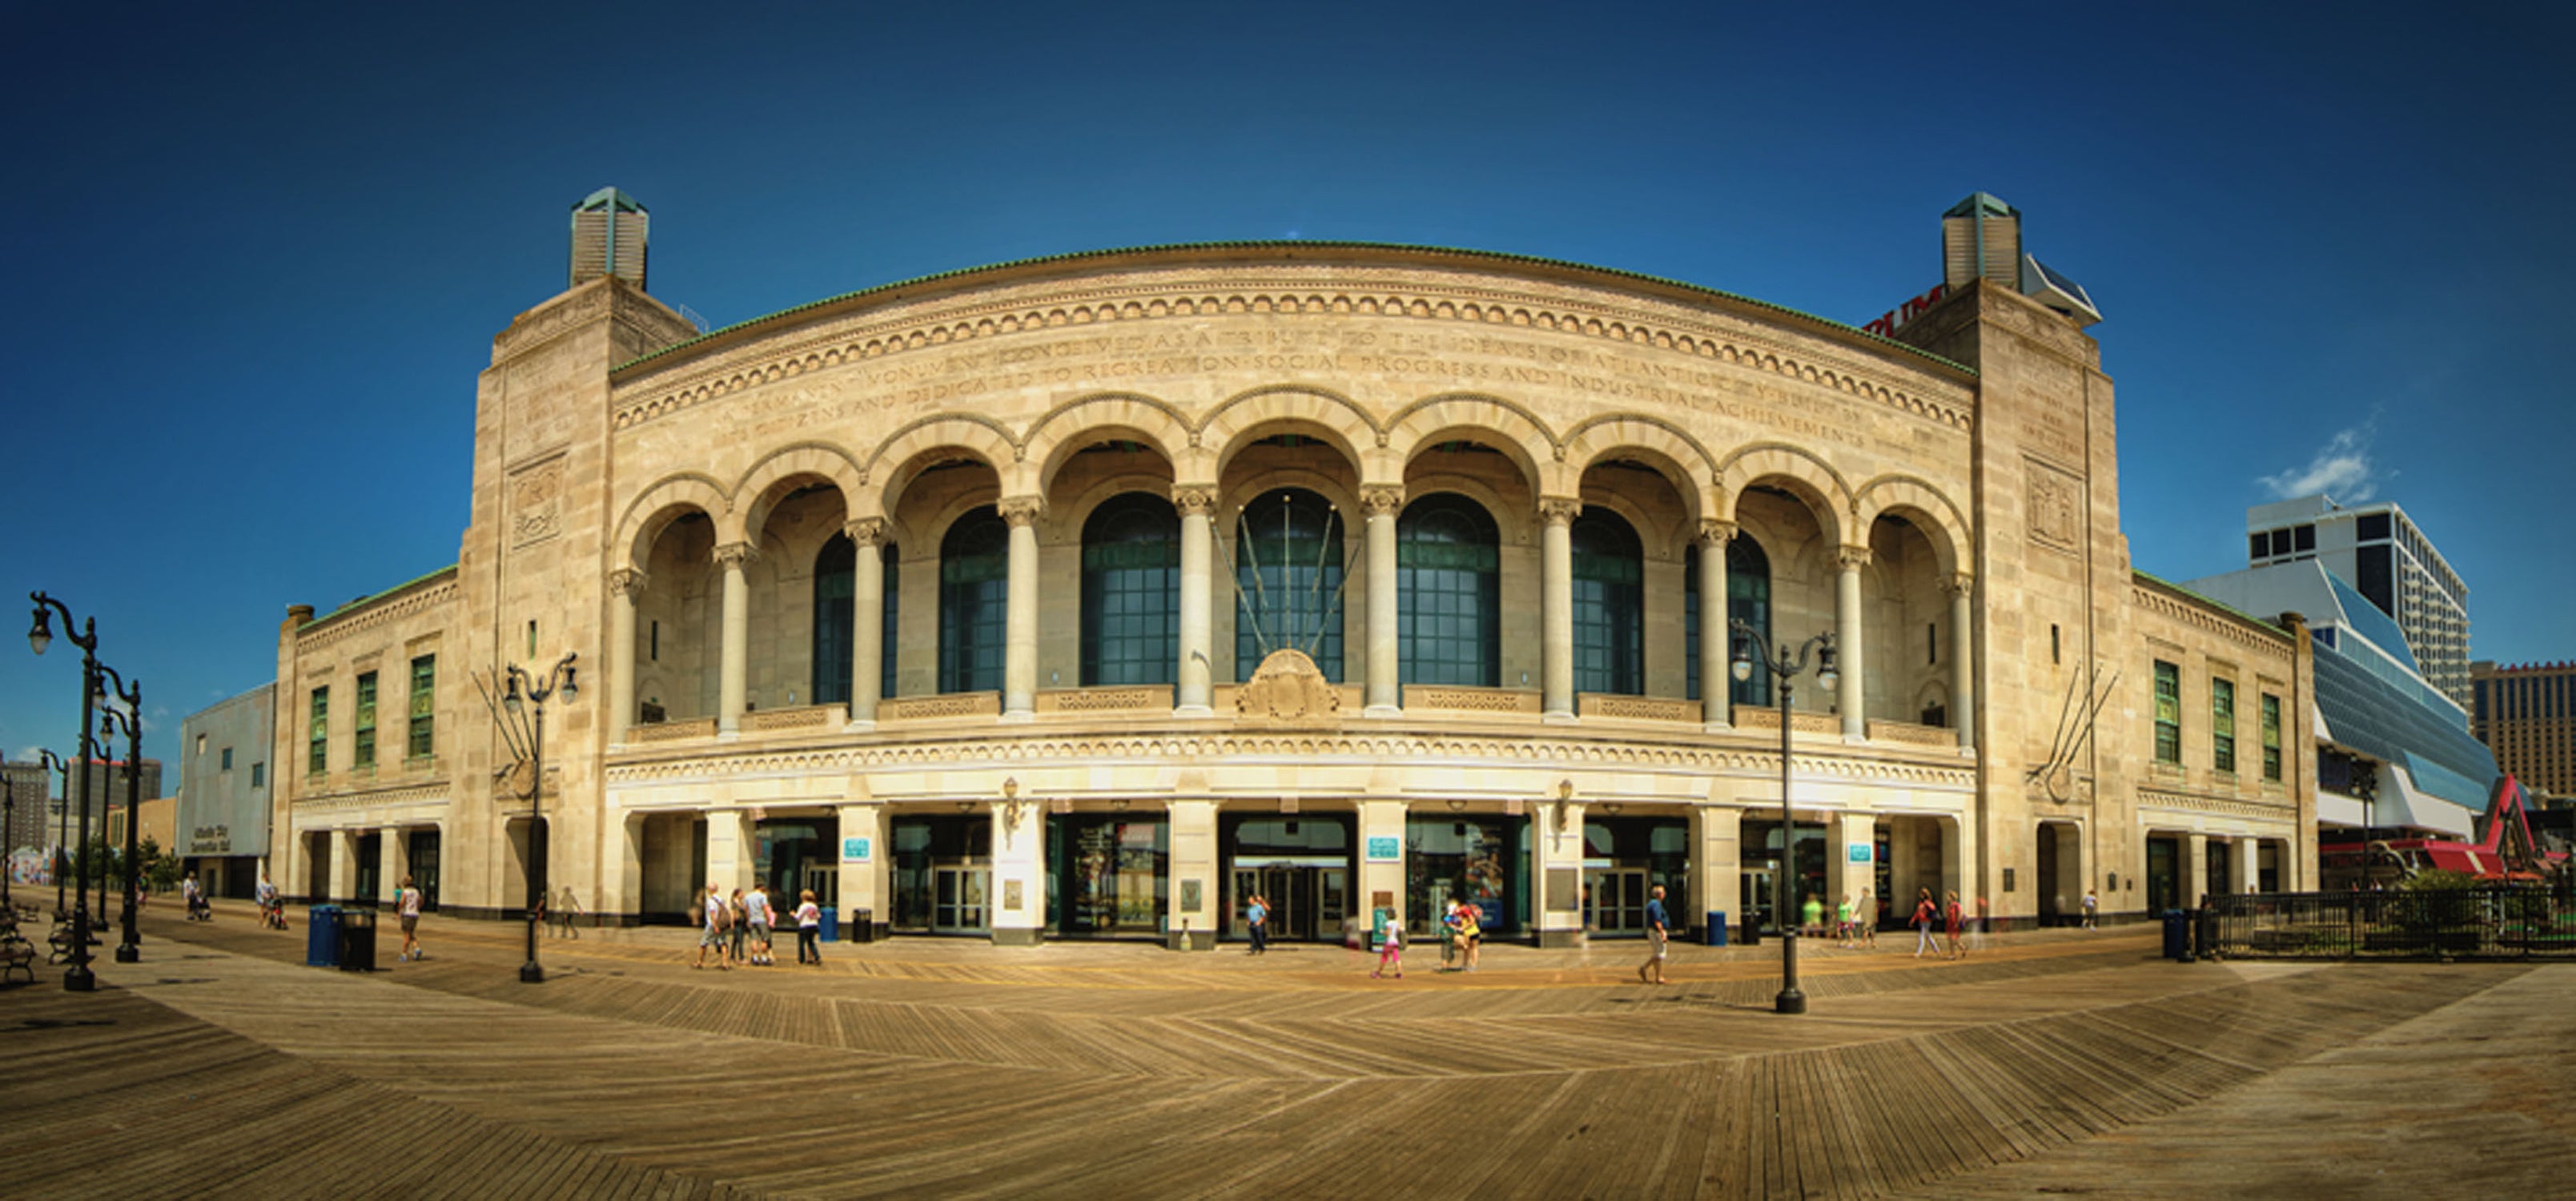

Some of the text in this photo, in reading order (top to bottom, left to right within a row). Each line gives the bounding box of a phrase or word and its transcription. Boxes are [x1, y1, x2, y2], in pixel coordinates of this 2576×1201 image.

[999, 335, 1145, 365] CONCEIVED
[1154, 332, 1186, 347] AS
[1195, 331, 1212, 347] A
[1343, 330, 1376, 345] TO
[1389, 331, 1440, 351] THE
[1449, 336, 1537, 359] IDEALS
[1593, 353, 1710, 387] ATLANTIC
[853, 393, 896, 414] AND
[906, 372, 1032, 404] DEDICATED
[1040, 367, 1072, 384] TO
[1083, 355, 1240, 380] RECREATION
[1253, 354, 1347, 371] SOCIAL
[1360, 355, 1489, 379] PROGRESS
[1500, 366, 1551, 385] AND
[1562, 372, 1702, 409] INDUSTRIAL
[1714, 400, 1865, 448] ACHIEVEMENTS
